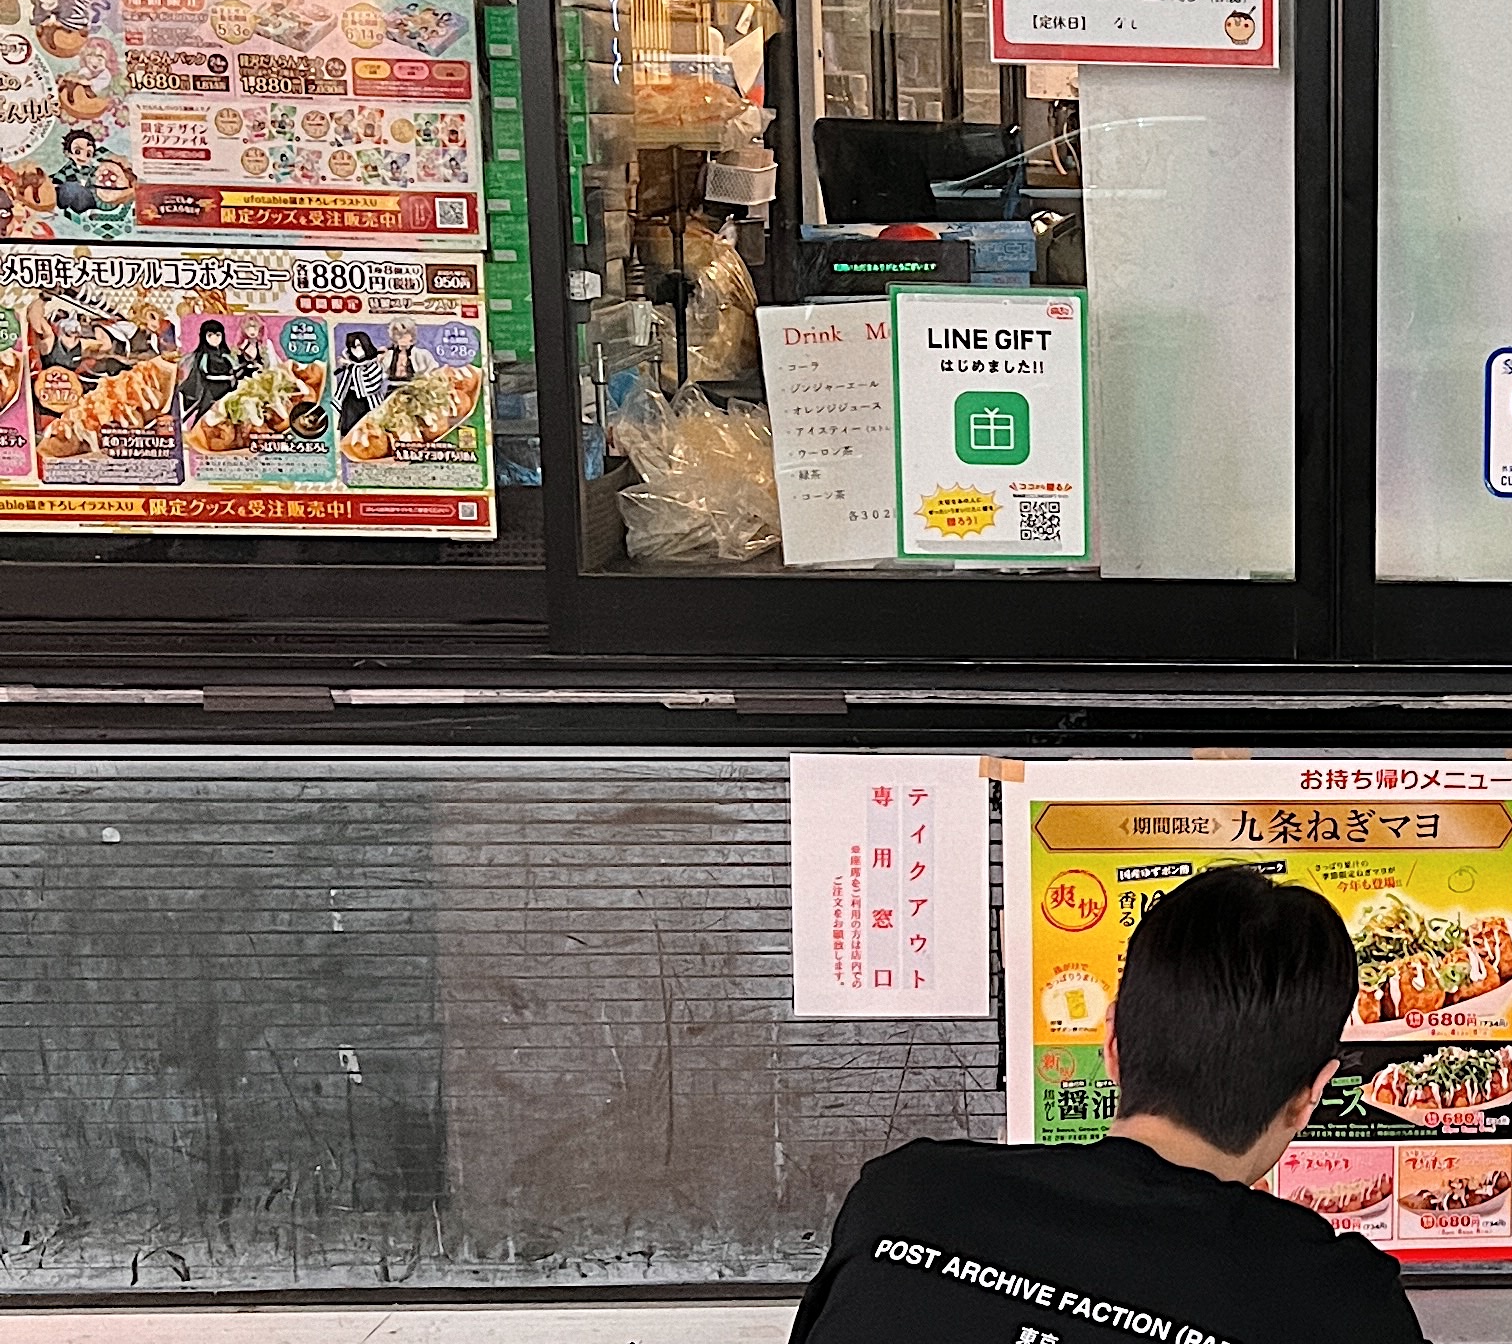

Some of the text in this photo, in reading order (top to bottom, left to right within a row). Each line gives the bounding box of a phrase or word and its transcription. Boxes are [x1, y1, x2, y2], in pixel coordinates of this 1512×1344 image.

[312, 263, 365, 290] 880
[783, 326, 843, 346] Drink
[927, 327, 1052, 351] LINE GIFT
[788, 361, 820, 372] コーラ
[940, 358, 1045, 375] はじめました!!
[1230, 807, 1442, 845] 九条ねぎマヨ
[871, 785, 895, 988] 専用窓口
[908, 788, 929, 990] テイクアウト
[1050, 883, 1102, 920] 爽快
[1117, 890, 1137, 928] 香る
[1058, 1089, 1117, 1121] 醤油
[874, 1238, 942, 1270] POST
[942, 1256, 1056, 1308] ARCHIVE
[1058, 1291, 1172, 1342] FACTION
